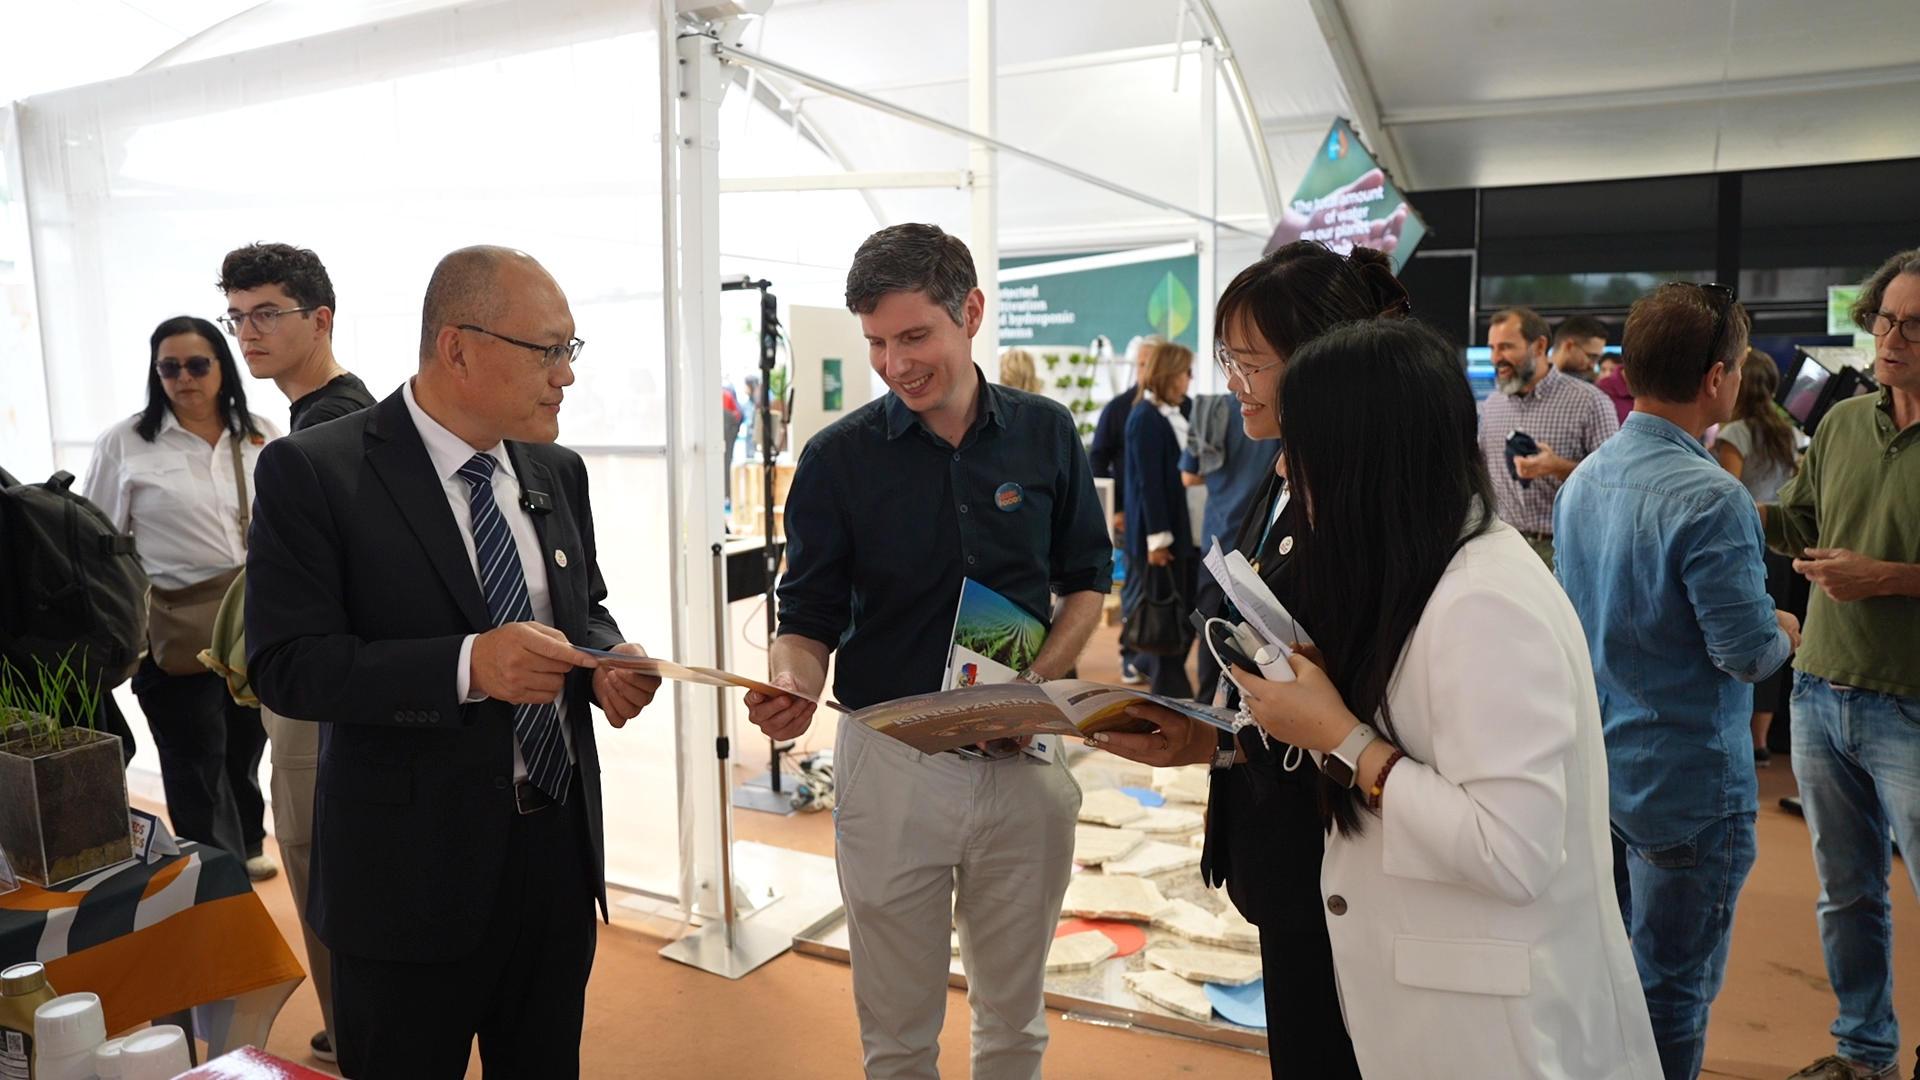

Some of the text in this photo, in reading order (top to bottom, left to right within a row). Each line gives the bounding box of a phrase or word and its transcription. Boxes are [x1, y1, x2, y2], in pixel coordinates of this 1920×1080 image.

[1340, 186, 1384, 206] amount
[1324, 206, 1370, 224] of water
[1315, 227, 1334, 240] our
[1008, 311, 1075, 327] hydroponic
